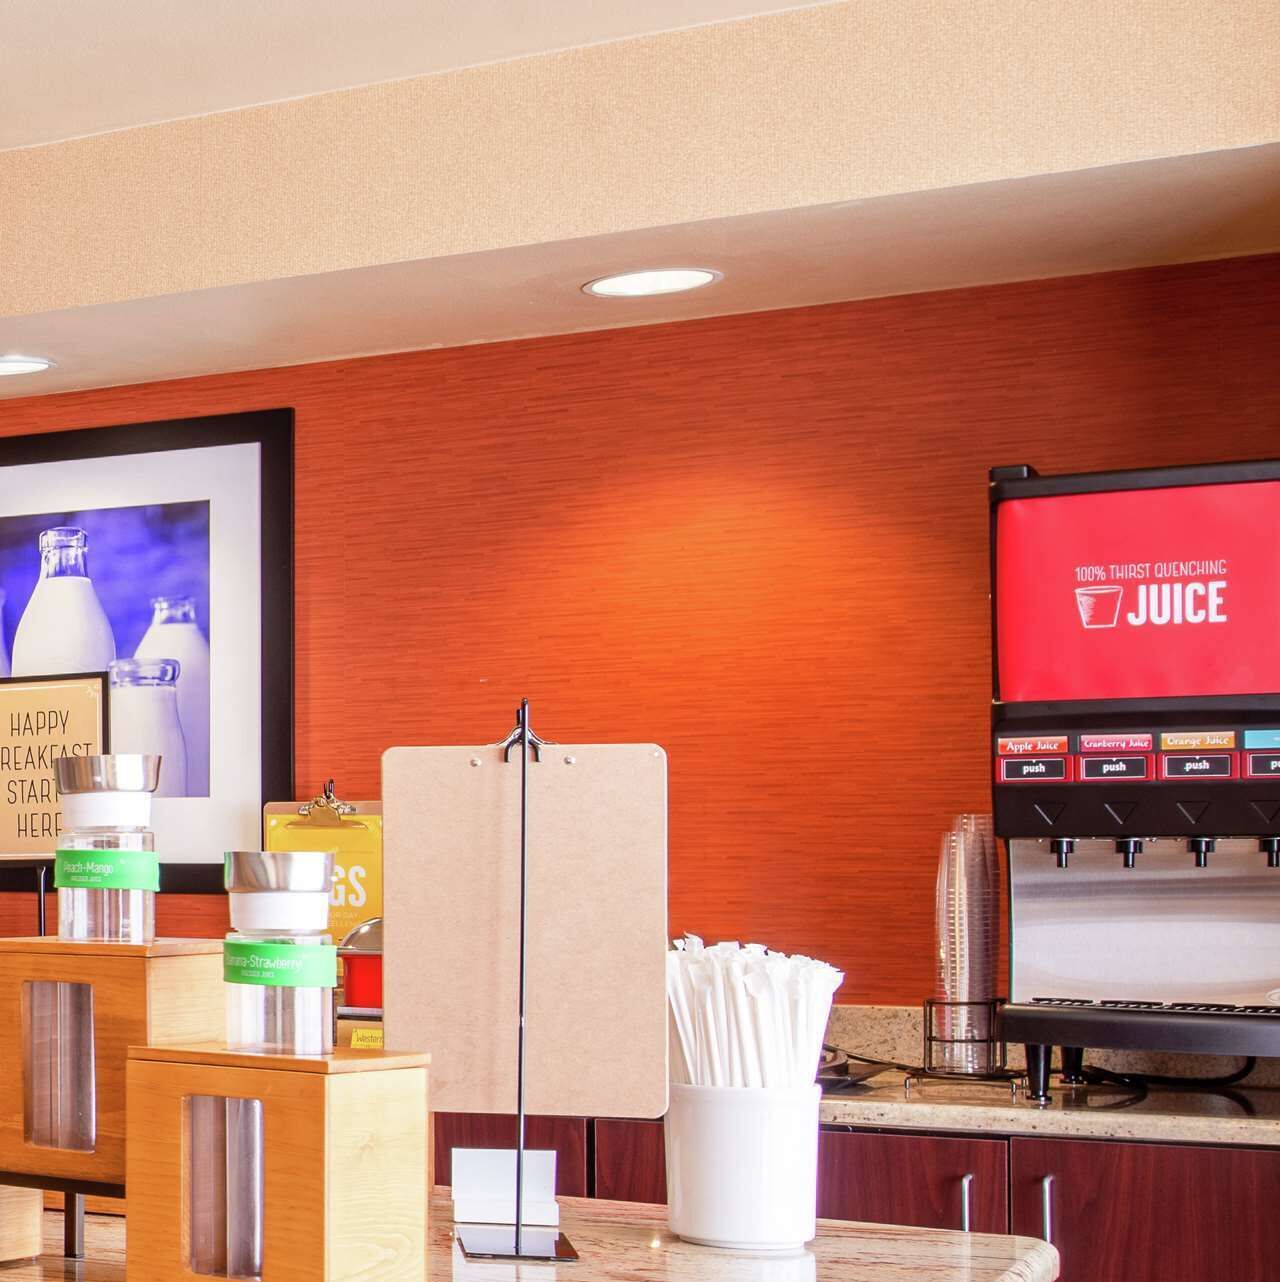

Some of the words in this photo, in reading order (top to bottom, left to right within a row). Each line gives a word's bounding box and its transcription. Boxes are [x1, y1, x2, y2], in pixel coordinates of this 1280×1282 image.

[1075, 566, 1106, 582] 100%
[1109, 563, 1151, 580] THIRST
[1154, 559, 1227, 578] QUENCHING
[1126, 580, 1228, 626] JUICE
[9, 709, 70, 737] HAPPY
[1006, 741, 1033, 753] Apple
[1036, 740, 1058, 750] Juice
[1083, 739, 1127, 751] Cranberry
[1129, 738, 1149, 748] Juice
[1166, 736, 1203, 747] Orange
[1206, 735, 1229, 746] Juice
[1022, 762, 1046, 775] push
[1102, 761, 1127, 774] push
[1185, 760, 1210, 773] push
